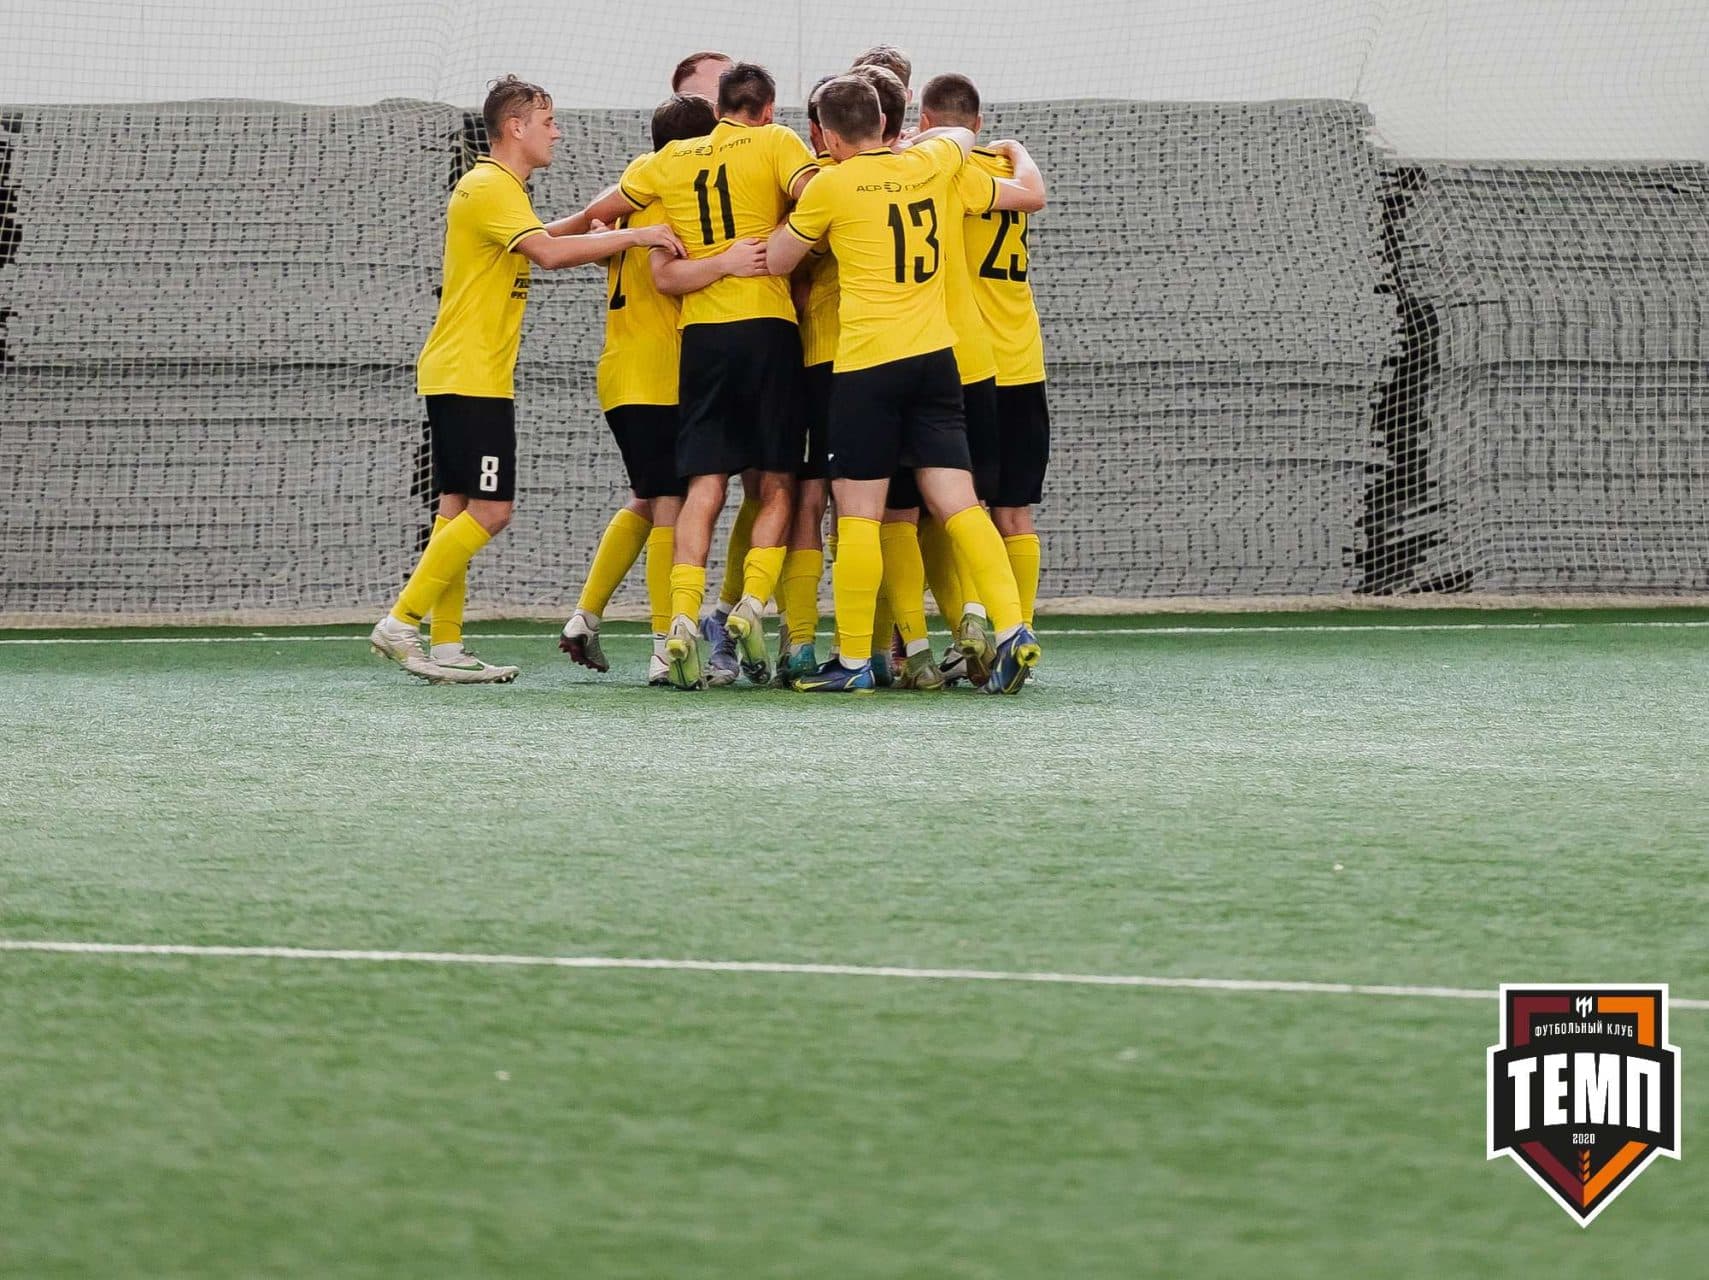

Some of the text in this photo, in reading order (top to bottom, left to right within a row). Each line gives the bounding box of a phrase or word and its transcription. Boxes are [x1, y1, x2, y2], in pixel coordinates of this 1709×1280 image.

[693, 162, 736, 246] 11
[887, 197, 940, 284] 13
[979, 209, 1030, 282] 23
[480, 456, 499, 492] 8
